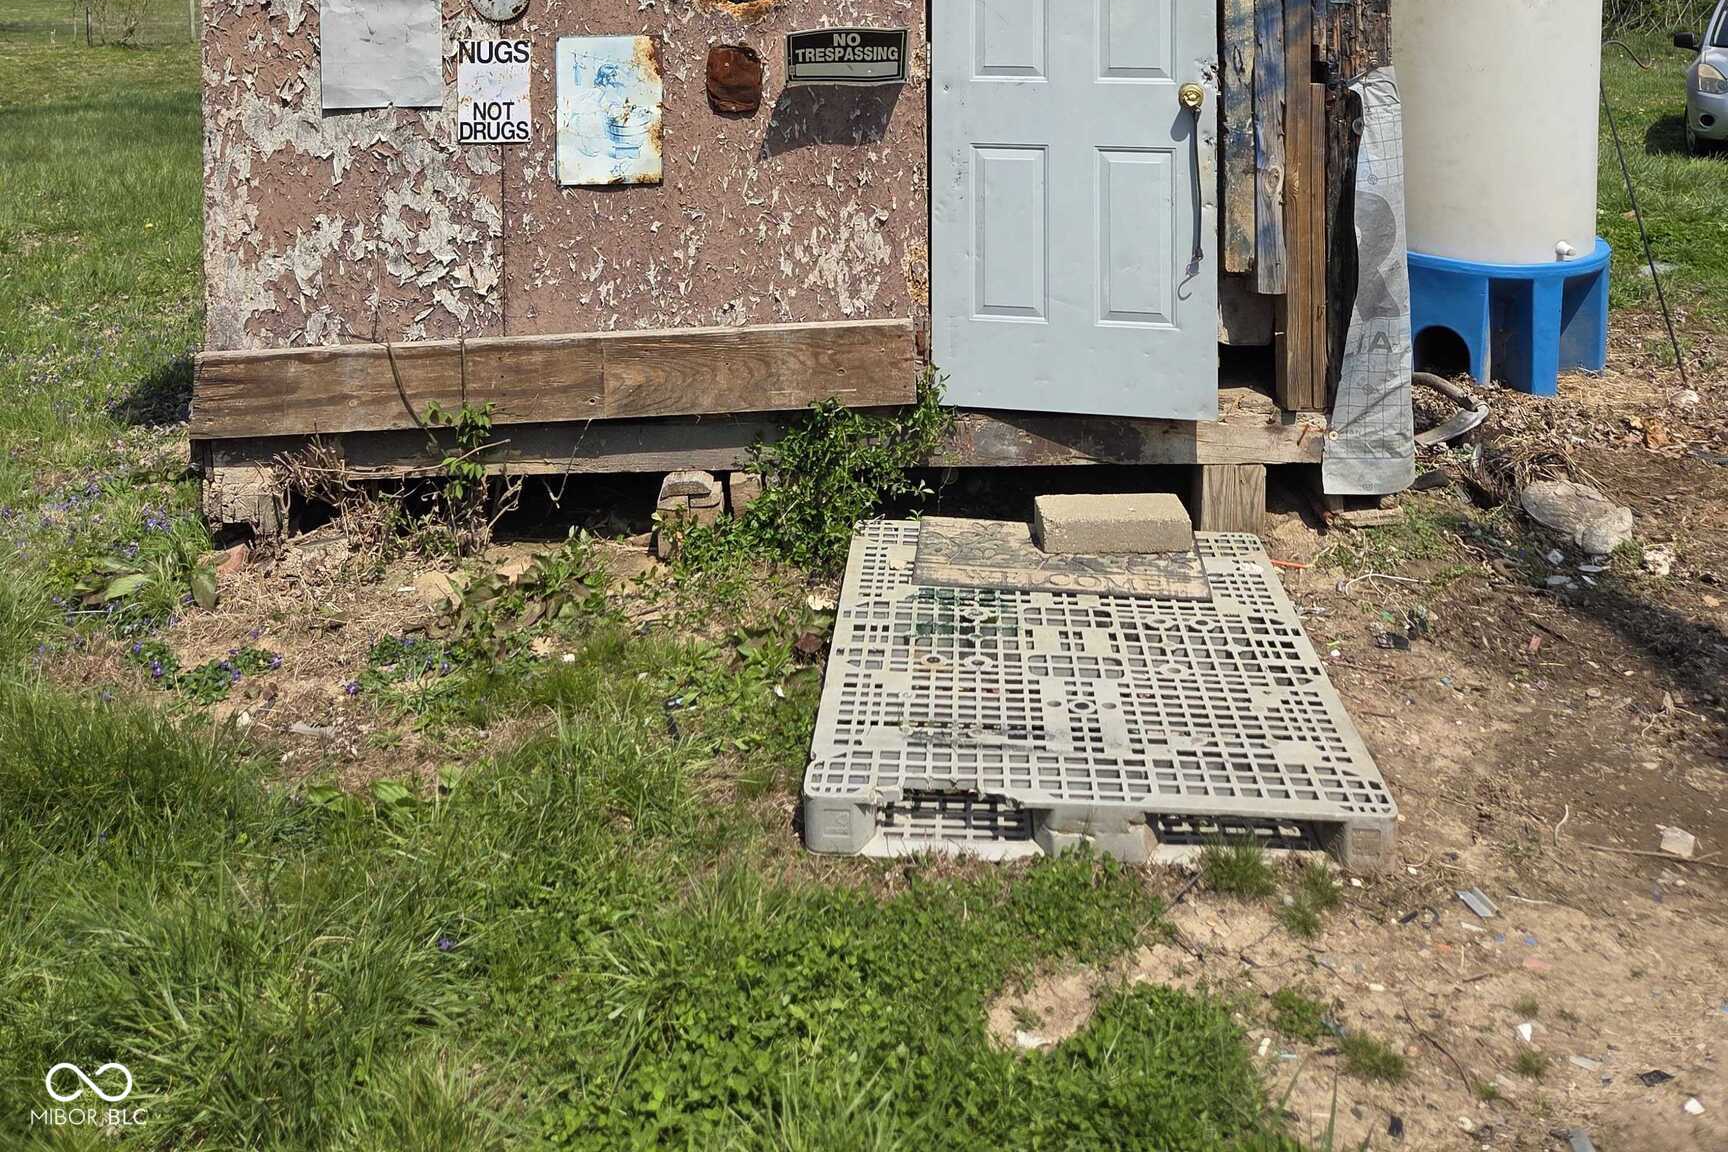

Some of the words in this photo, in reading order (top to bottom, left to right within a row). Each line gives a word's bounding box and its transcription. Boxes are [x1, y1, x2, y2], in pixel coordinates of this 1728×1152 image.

[833, 33, 861, 46] NO
[459, 40, 530, 64] NUGS
[795, 47, 899, 62] TRESPASSING
[473, 101, 515, 121] NOT
[459, 121, 530, 140] DRUGS
[965, 570, 1163, 593] WELCOME
